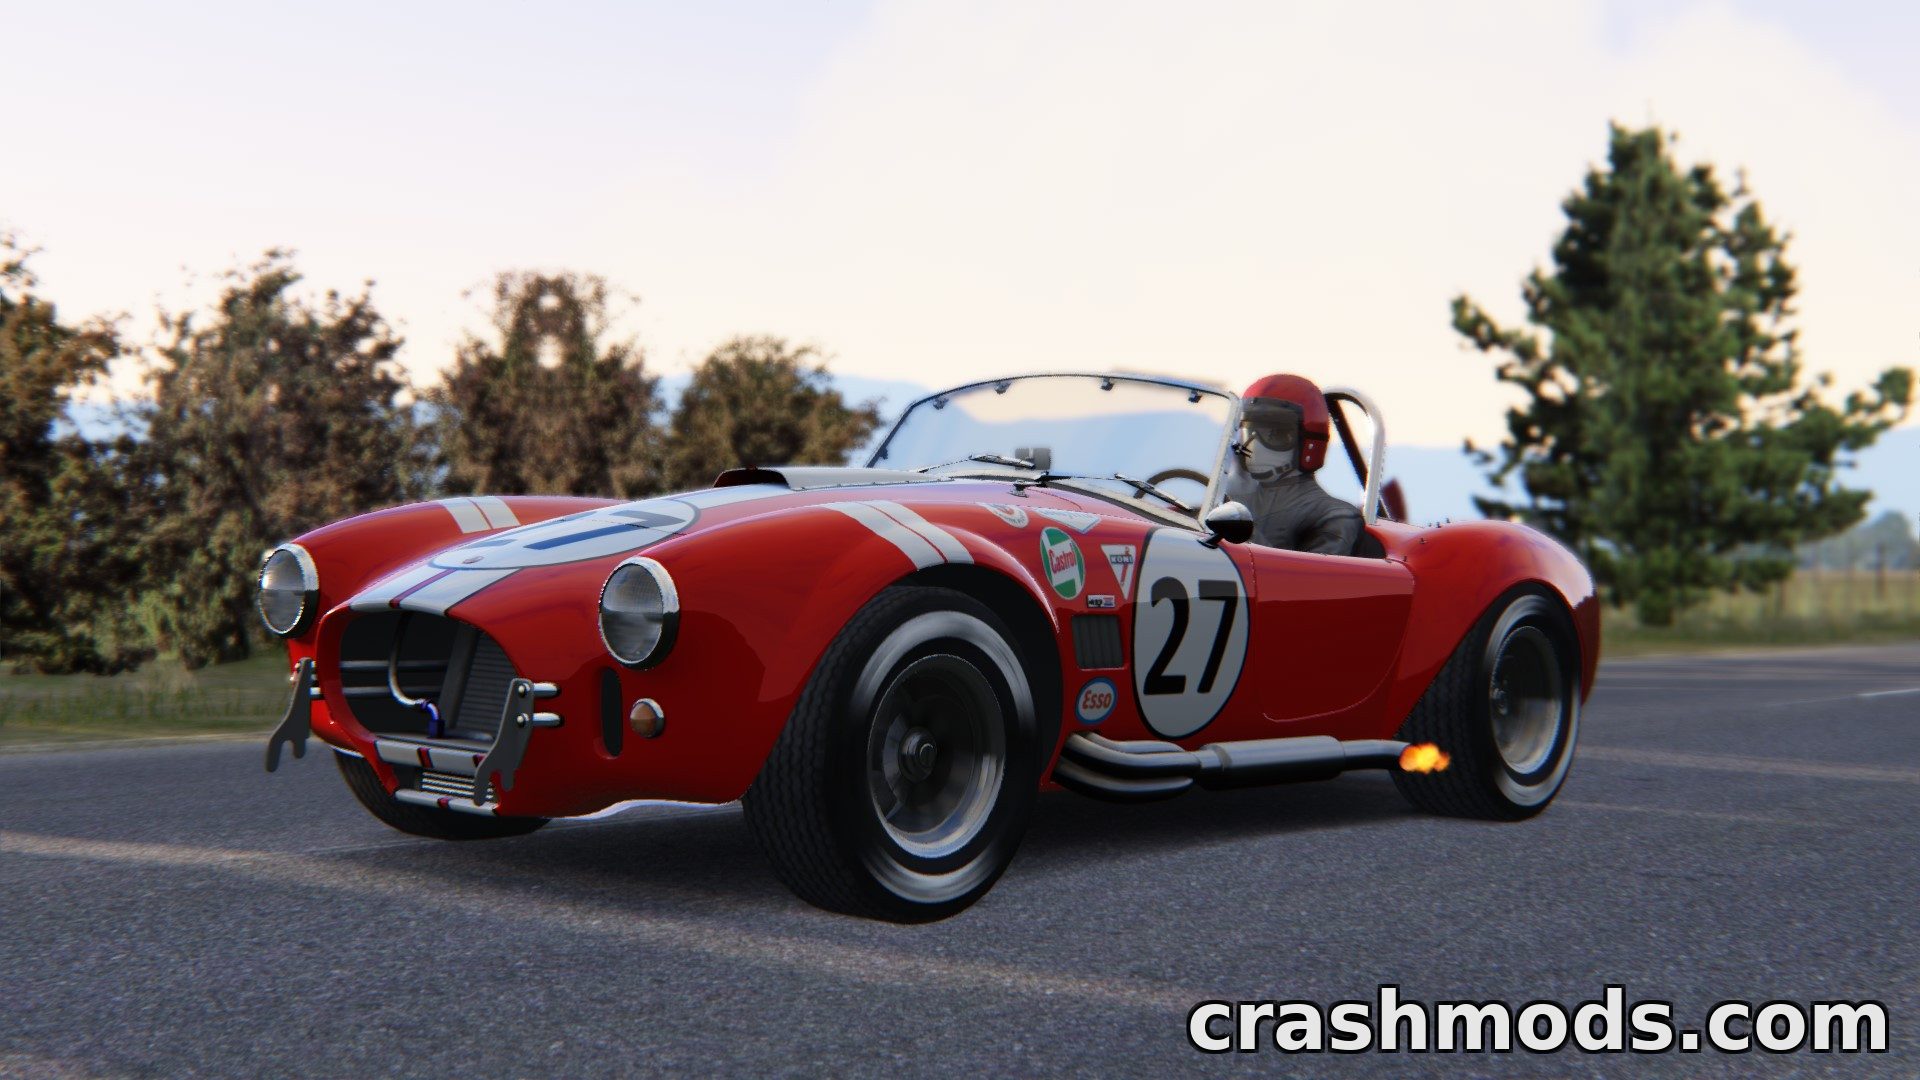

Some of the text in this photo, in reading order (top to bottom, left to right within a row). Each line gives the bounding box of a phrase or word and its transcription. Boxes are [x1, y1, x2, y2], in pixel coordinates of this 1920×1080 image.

[1048, 542, 1077, 574] Castrol
[1110, 554, 1133, 565] KONI
[1142, 576, 1238, 695] 27
